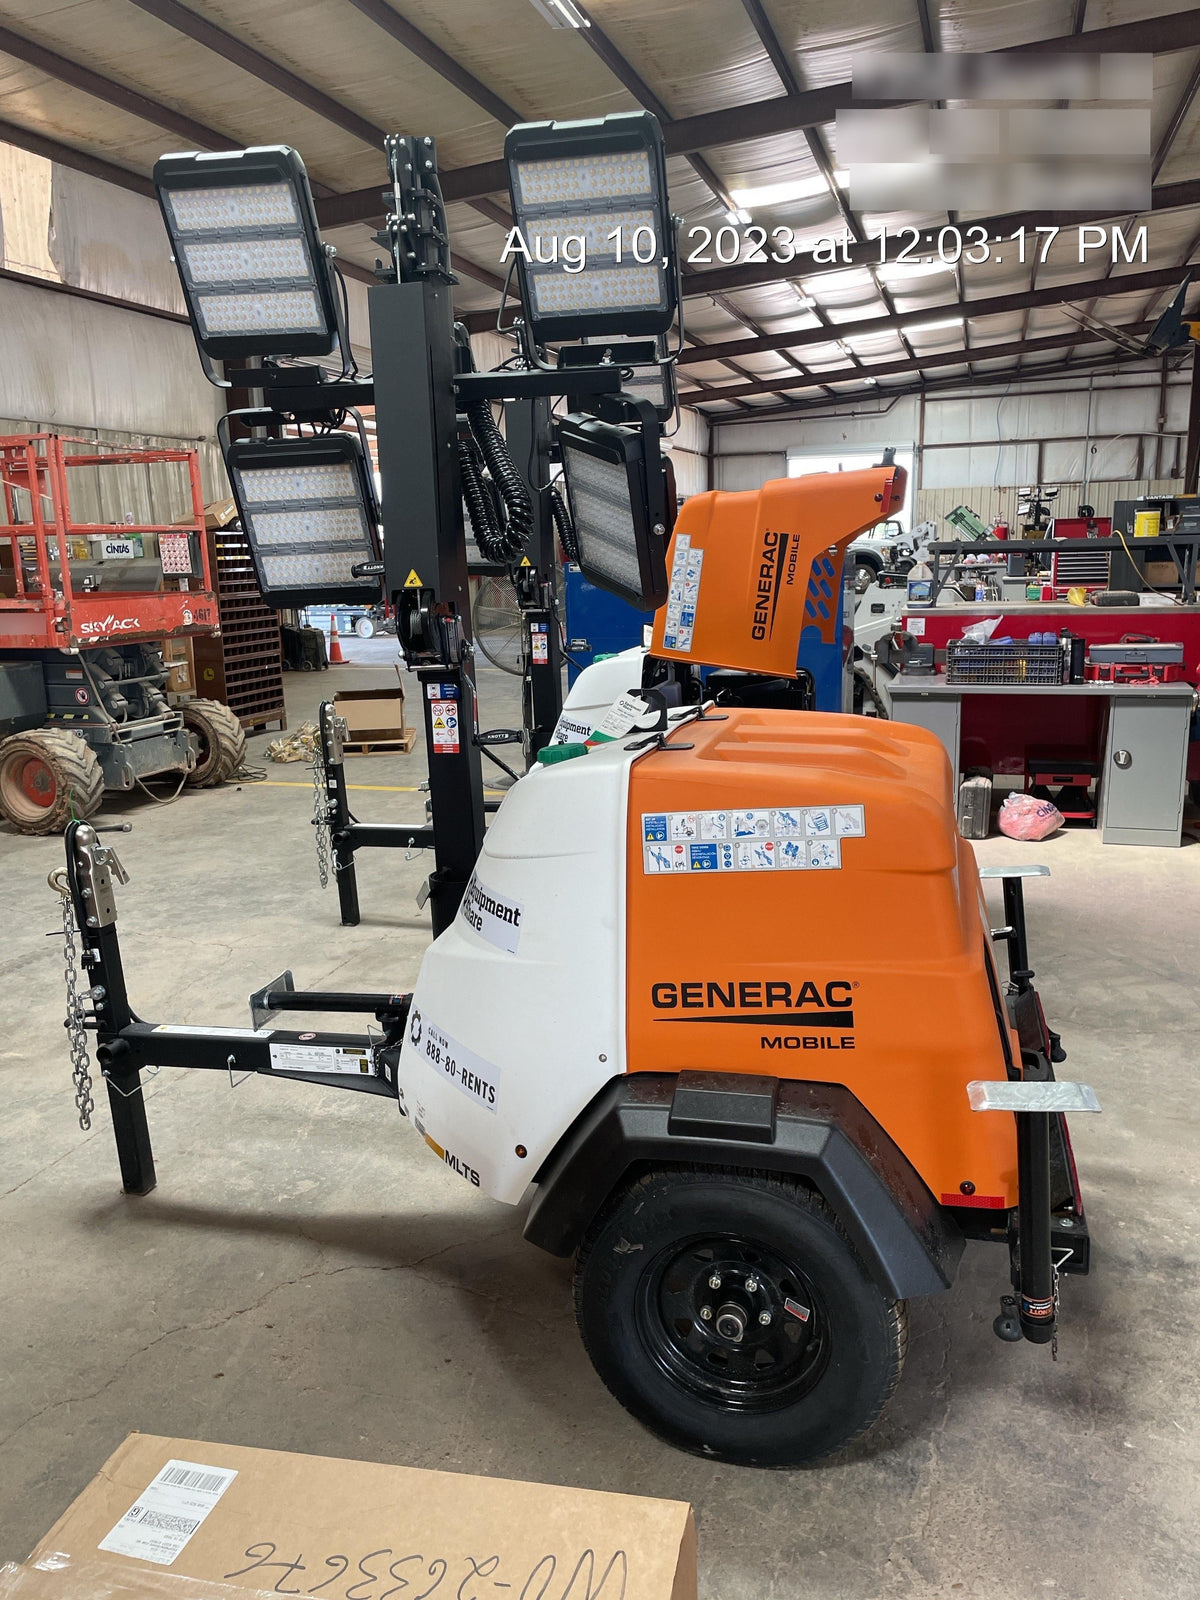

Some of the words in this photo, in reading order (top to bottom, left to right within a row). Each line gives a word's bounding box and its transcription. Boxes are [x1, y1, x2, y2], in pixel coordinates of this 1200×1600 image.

[1090, 443, 1098, 455] 6
[786, 534, 800, 585] MOBILE
[751, 532, 779, 640] GENERAC
[651, 981, 853, 1008] GENERAC
[428, 1026, 438, 1041] CALL
[439, 1036, 449, 1049] NOW
[760, 1036, 856, 1049] MOBILE
[426, 1039, 496, 1104] 888-80-RENTS
[445, 1149, 480, 1187] MLTS
